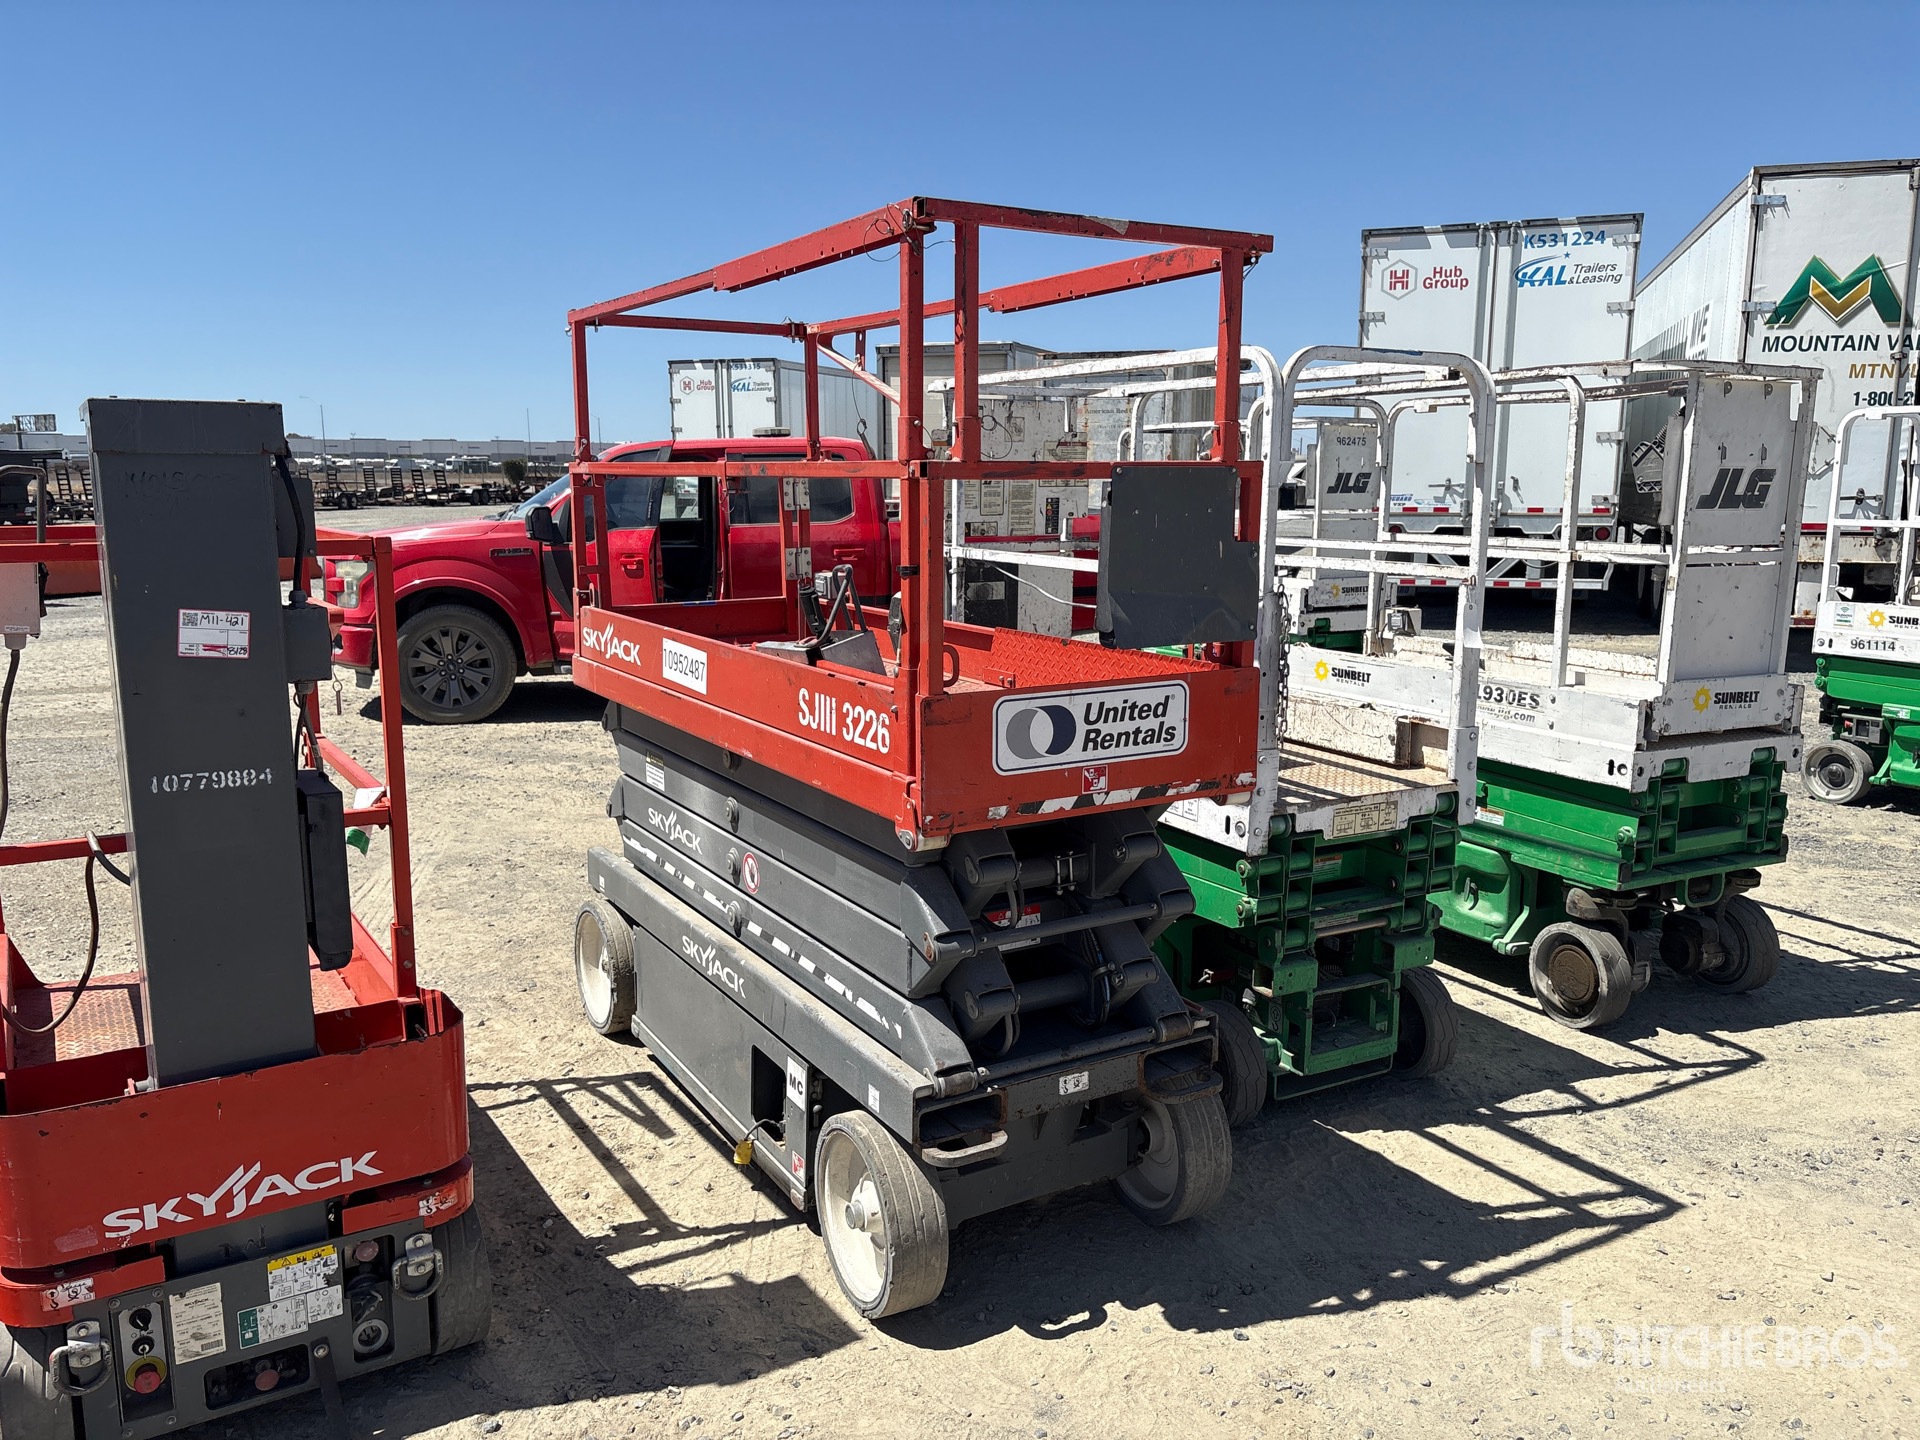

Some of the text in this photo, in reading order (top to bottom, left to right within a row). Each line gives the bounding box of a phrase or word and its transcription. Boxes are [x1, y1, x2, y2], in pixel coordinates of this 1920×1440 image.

[1524, 230, 1606, 249] K531224
[1433, 266, 1463, 279] Hub
[1517, 262, 1617, 288] KAL Trailers
[1422, 278, 1469, 291] Group
[1761, 334, 1880, 353] MOUNTAIN
[696, 384, 716, 393] Group
[1336, 436, 1367, 447] 962475
[1326, 472, 1373, 494] JLG
[1695, 468, 1777, 509] JLG
[1341, 585, 1369, 594] SUNBELT
[1888, 615, 1920, 626] SUNB
[582, 621, 642, 666] SKYJACK
[1850, 638, 1896, 652] 961114
[663, 648, 706, 682] 10952487
[1331, 667, 1372, 683] SUNBELT
[1713, 690, 1760, 704] SUNBELT
[1083, 695, 1171, 726] United
[842, 701, 890, 754] 3226
[1082, 720, 1177, 753] Rentals
[151, 767, 273, 794] 10779884
[647, 807, 703, 856] SKYJACK
[682, 935, 747, 1000] SKYJACK
[789, 1072, 804, 1096] MC
[102, 1150, 384, 1239] SKYJACK
